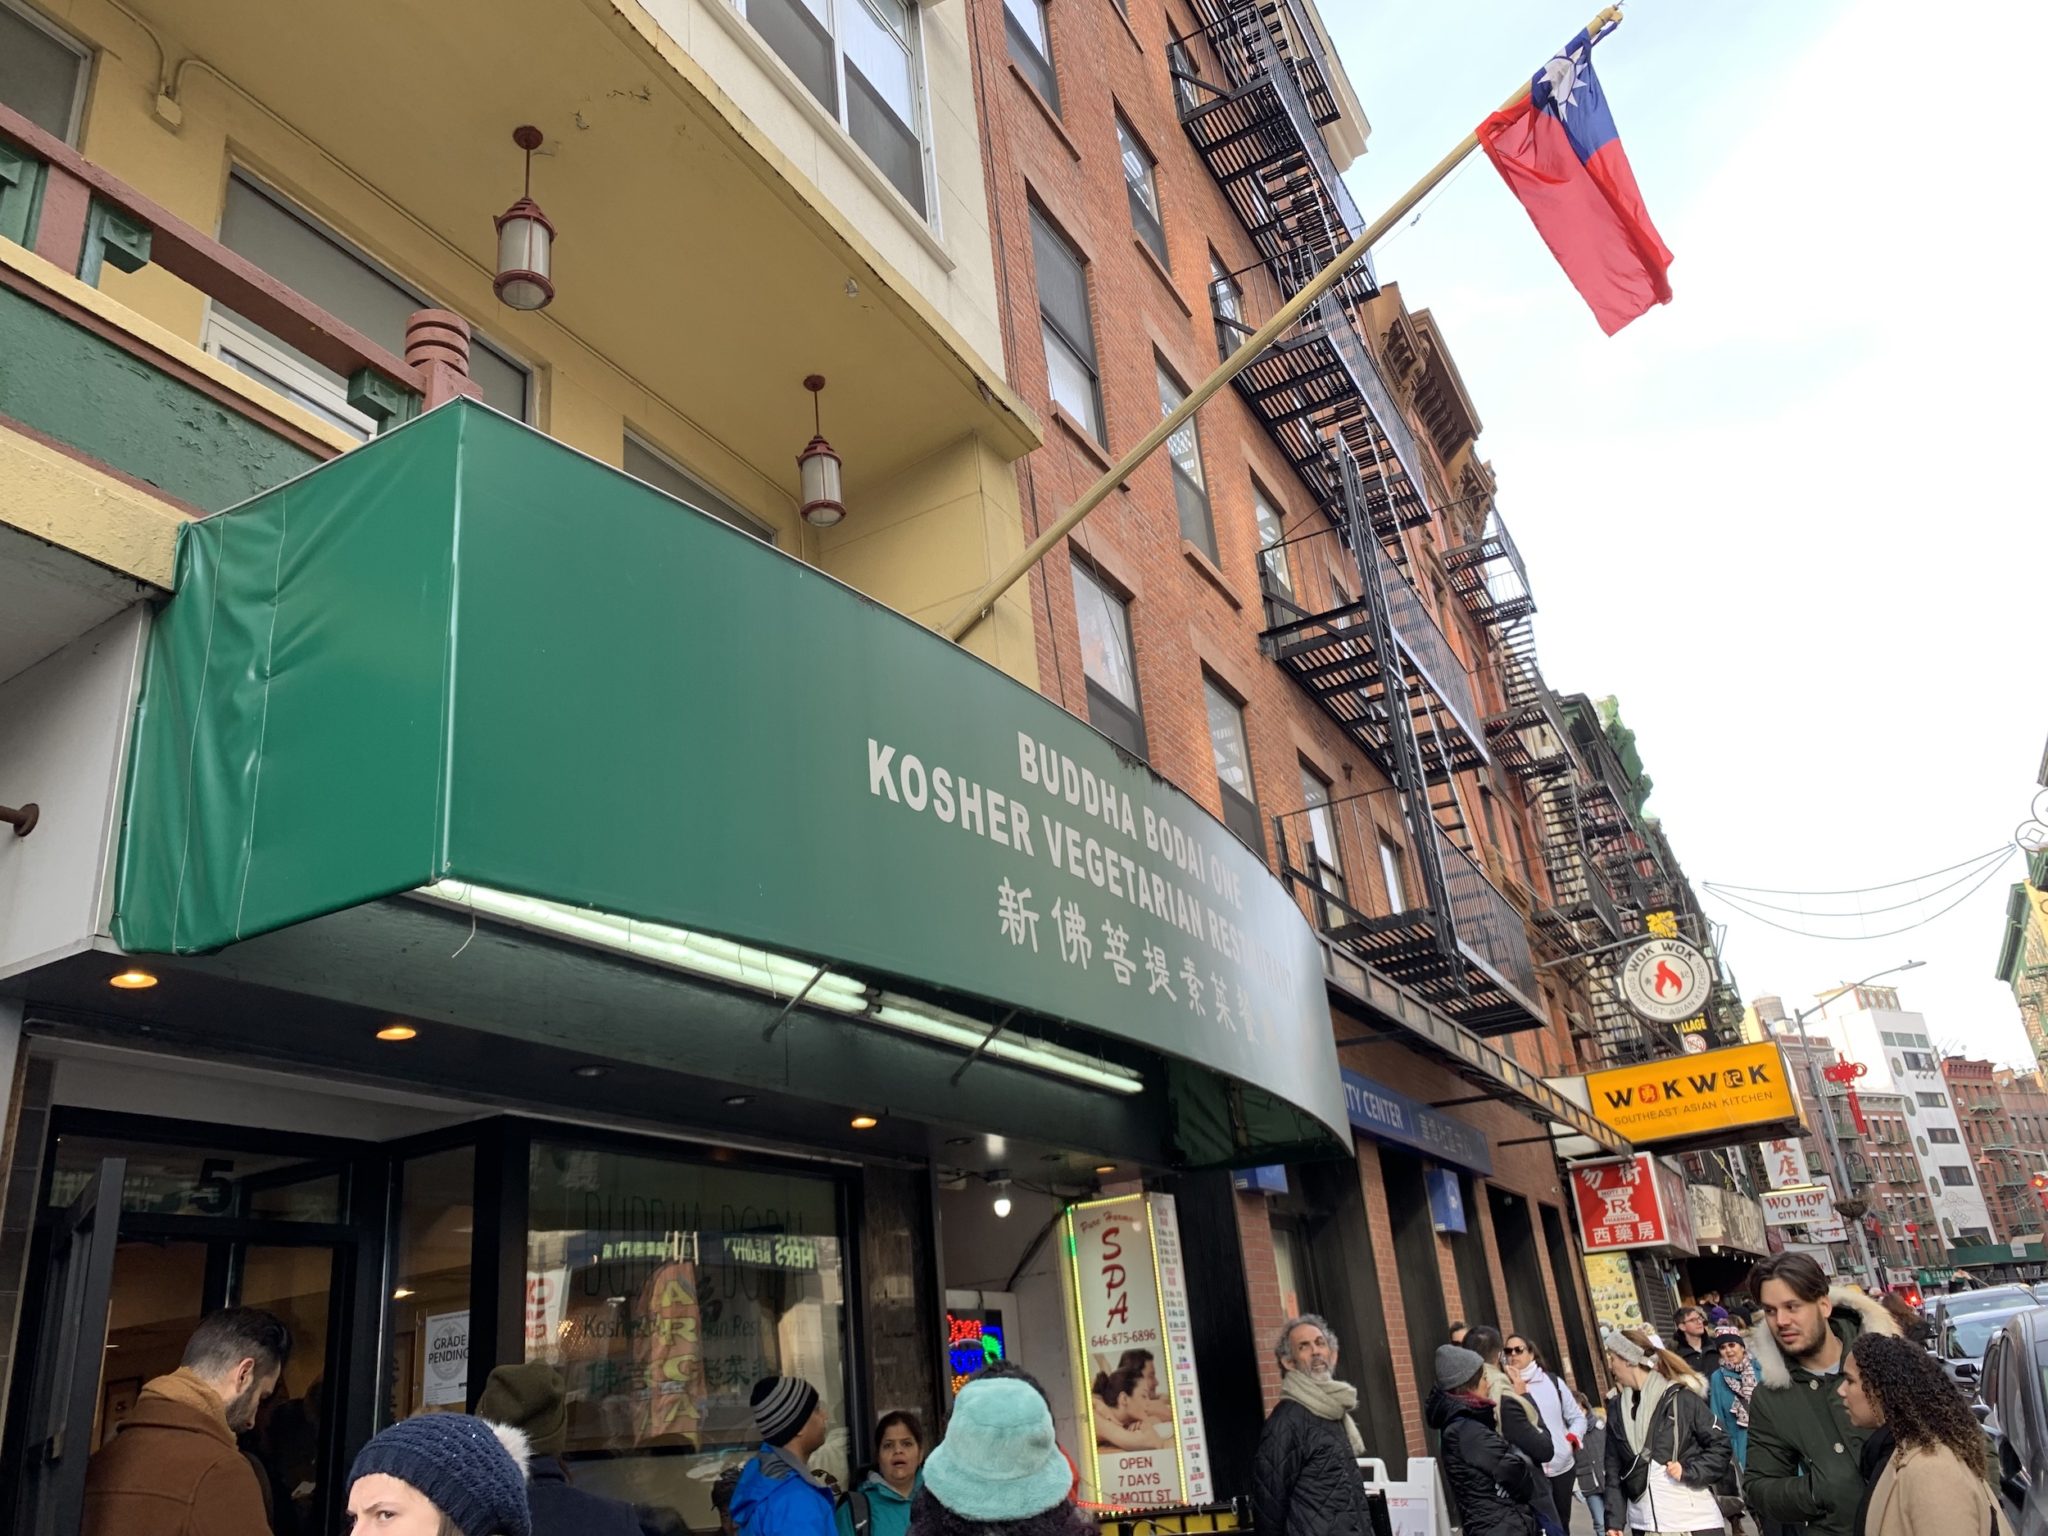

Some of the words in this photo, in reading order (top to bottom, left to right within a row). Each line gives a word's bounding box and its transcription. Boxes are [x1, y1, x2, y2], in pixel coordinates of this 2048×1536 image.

[1017, 731, 1138, 841] BUDDHA
[1143, 806, 1206, 885] BODAI
[1210, 857, 1242, 911] ONE
[867, 738, 1034, 857] KOSHER
[1042, 815, 1205, 942] VEGETARIAN
[1628, 944, 1655, 973] WOK
[1660, 941, 1697, 961] WOK
[1362, 1091, 1404, 1130] CENTER
[1614, 1107, 1679, 1126] SOUTHEAST
[1683, 1101, 1717, 1114] ASIAN
[1722, 1092, 1773, 1107] KITCHEN
[1766, 1197, 1791, 1210] WO
[1795, 1193, 1825, 1206] HOP
[1777, 1210, 1798, 1220] CITY
[1800, 1208, 1820, 1217] INC.
[1592, 1221, 1656, 1245] 西藥房
[1101, 1227, 1128, 1328] SPA
[433, 1335, 467, 1350] GRADE
[1091, 1329, 1156, 1347] 646-875-6896
[1119, 1456, 1152, 1470] OPEN
[1118, 1475, 1125, 1487] 7
[1128, 1473, 1160, 1487] DAYS
[1120, 1491, 1153, 1504] MOTT
[1156, 1489, 1171, 1503] ST
